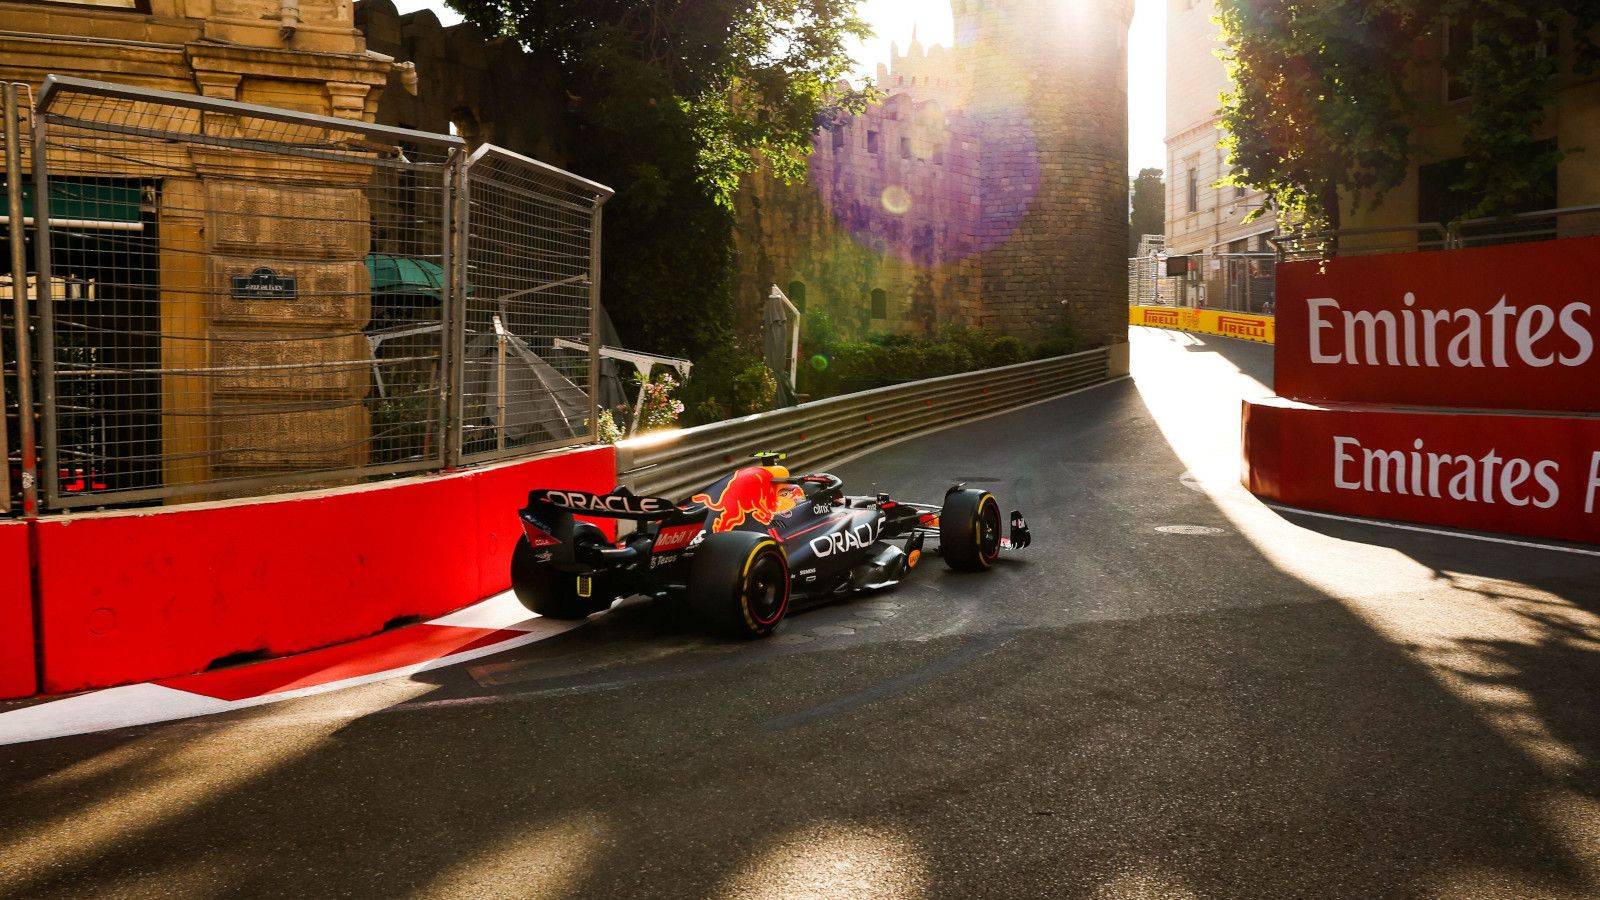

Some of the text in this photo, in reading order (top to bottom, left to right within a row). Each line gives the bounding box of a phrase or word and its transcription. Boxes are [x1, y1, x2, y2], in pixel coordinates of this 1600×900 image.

[1143, 309, 1179, 326] PIRELLI
[1217, 315, 1266, 338] PIRELLI
[1306, 291, 1595, 368] Emirates
[1332, 435, 1560, 509] Emirates
[545, 490, 660, 514] ORACLE
[655, 531, 686, 547] Mobil
